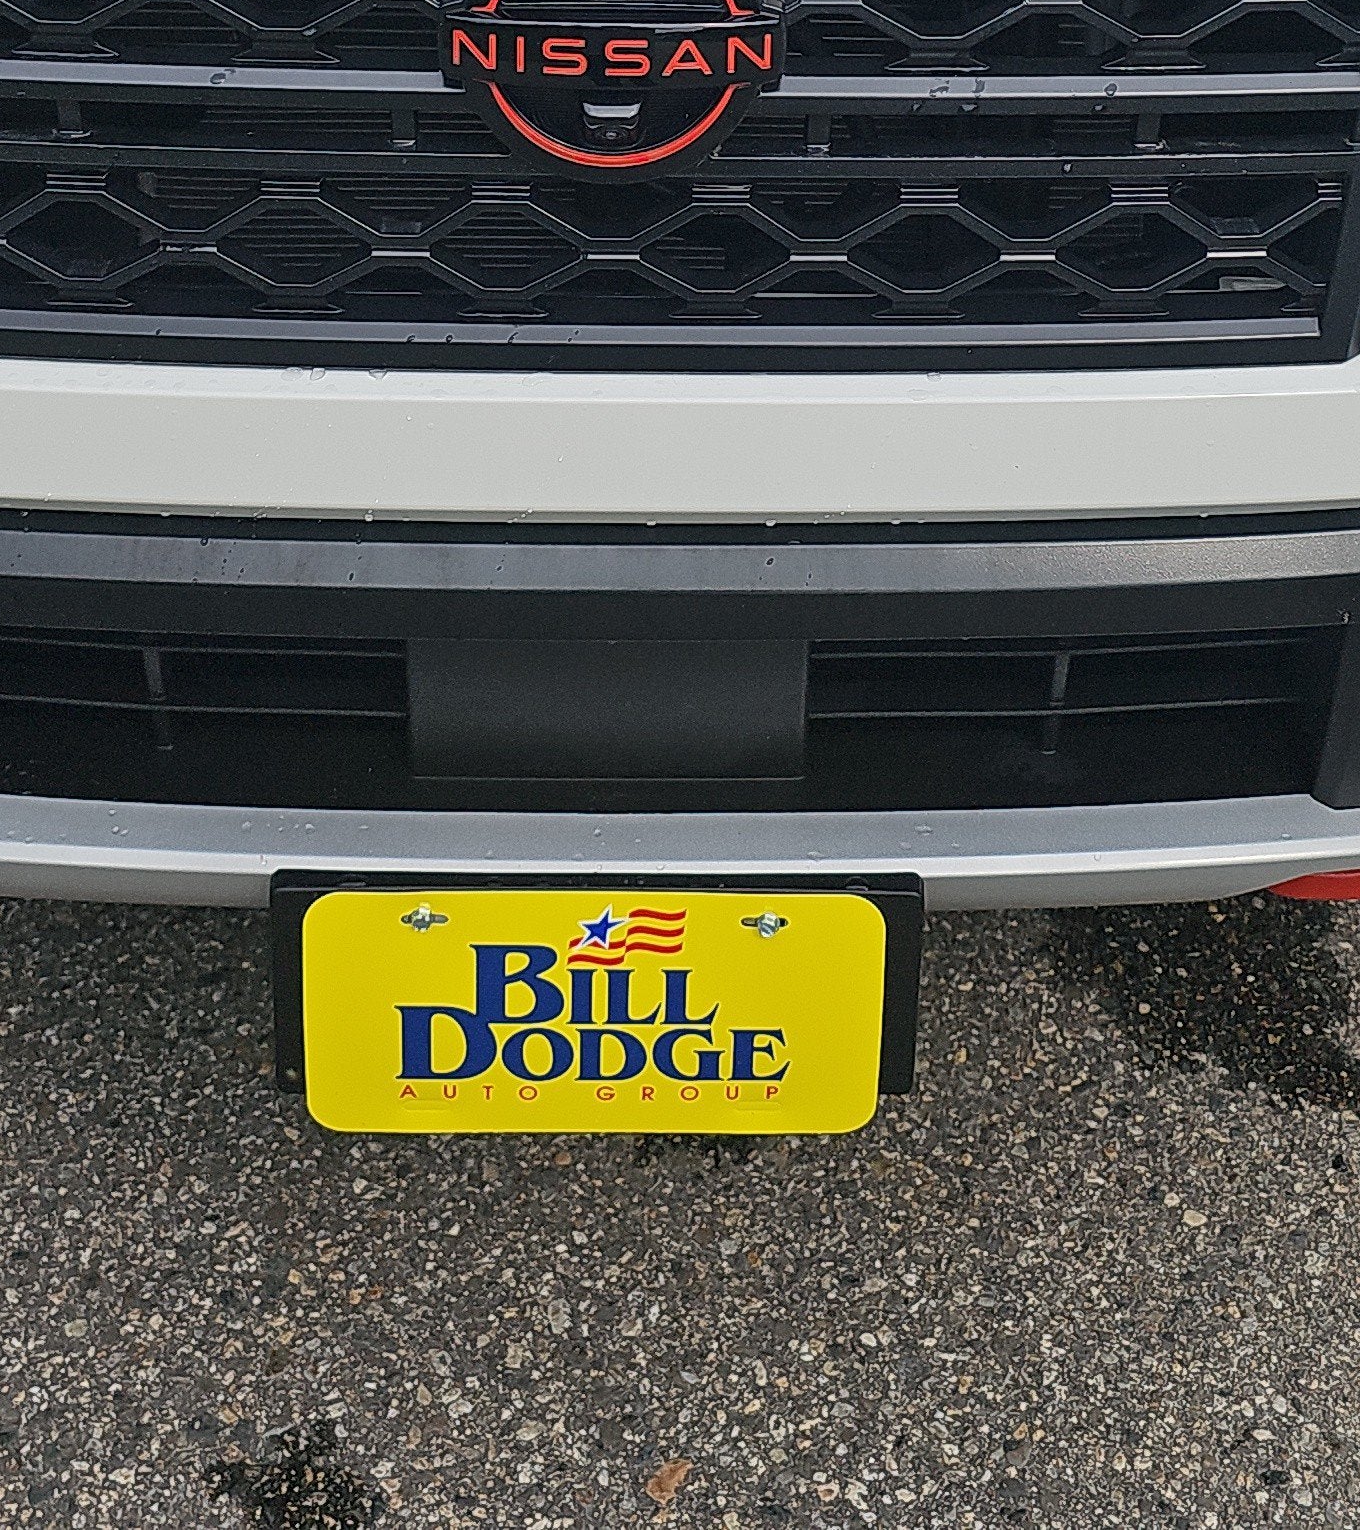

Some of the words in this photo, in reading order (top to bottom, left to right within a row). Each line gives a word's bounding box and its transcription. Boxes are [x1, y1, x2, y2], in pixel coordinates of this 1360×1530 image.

[451, 28, 773, 78] NISSAN
[469, 943, 720, 1025] BILL
[394, 1004, 791, 1082] DODGE
[398, 1084, 539, 1102] AUTO
[596, 1084, 782, 1102] GROUP
